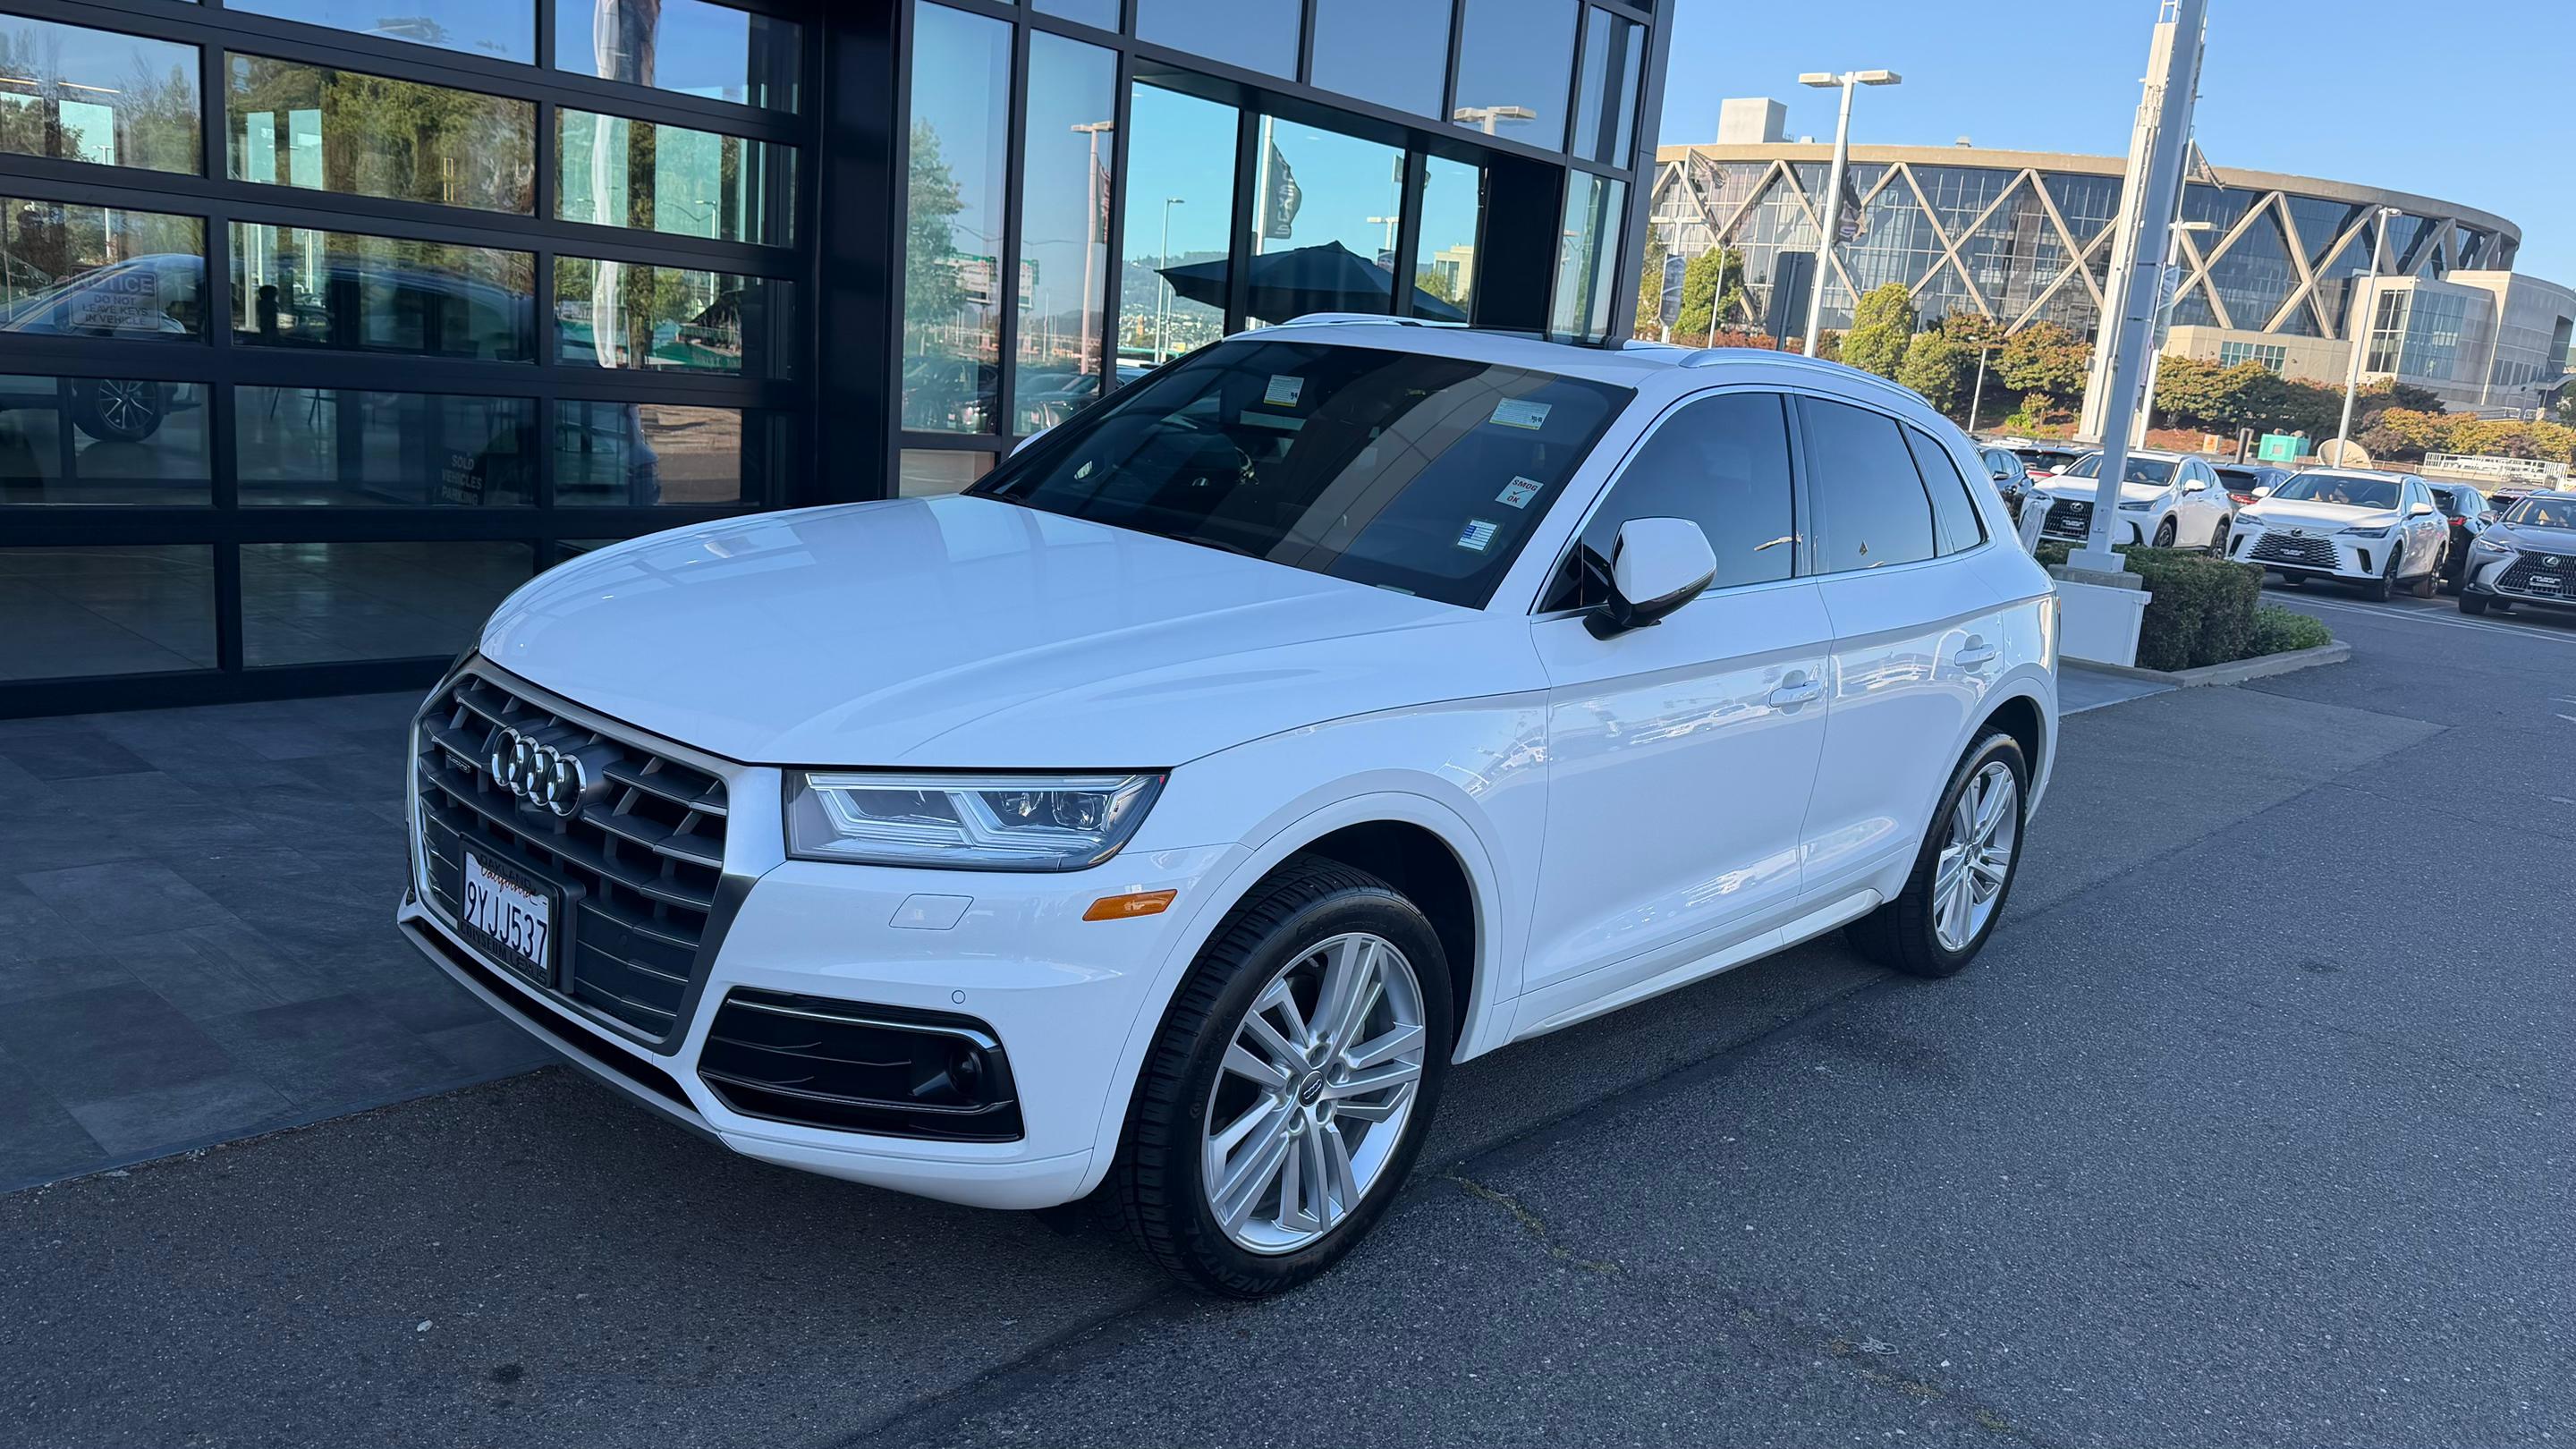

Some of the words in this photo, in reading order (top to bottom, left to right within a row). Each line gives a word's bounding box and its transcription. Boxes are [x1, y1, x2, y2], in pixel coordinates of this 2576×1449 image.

[94, 294, 110, 304] DO
[114, 295, 136, 305] NOT
[82, 304, 116, 314] LEAVE
[120, 307, 148, 316] KEYS
[85, 313, 97, 322] IN
[99, 315, 147, 326] VEHICLE
[451, 454, 475, 470] SOLD
[442, 468, 483, 490] VEHICLES
[1512, 479, 1538, 492] SMOG
[1506, 495, 1521, 504] OK
[479, 853, 532, 889] OAKLAND
[466, 881, 548, 967] 9YJJ537
[460, 921, 507, 960] COLISEUM
[510, 952, 547, 984] LEXUS
